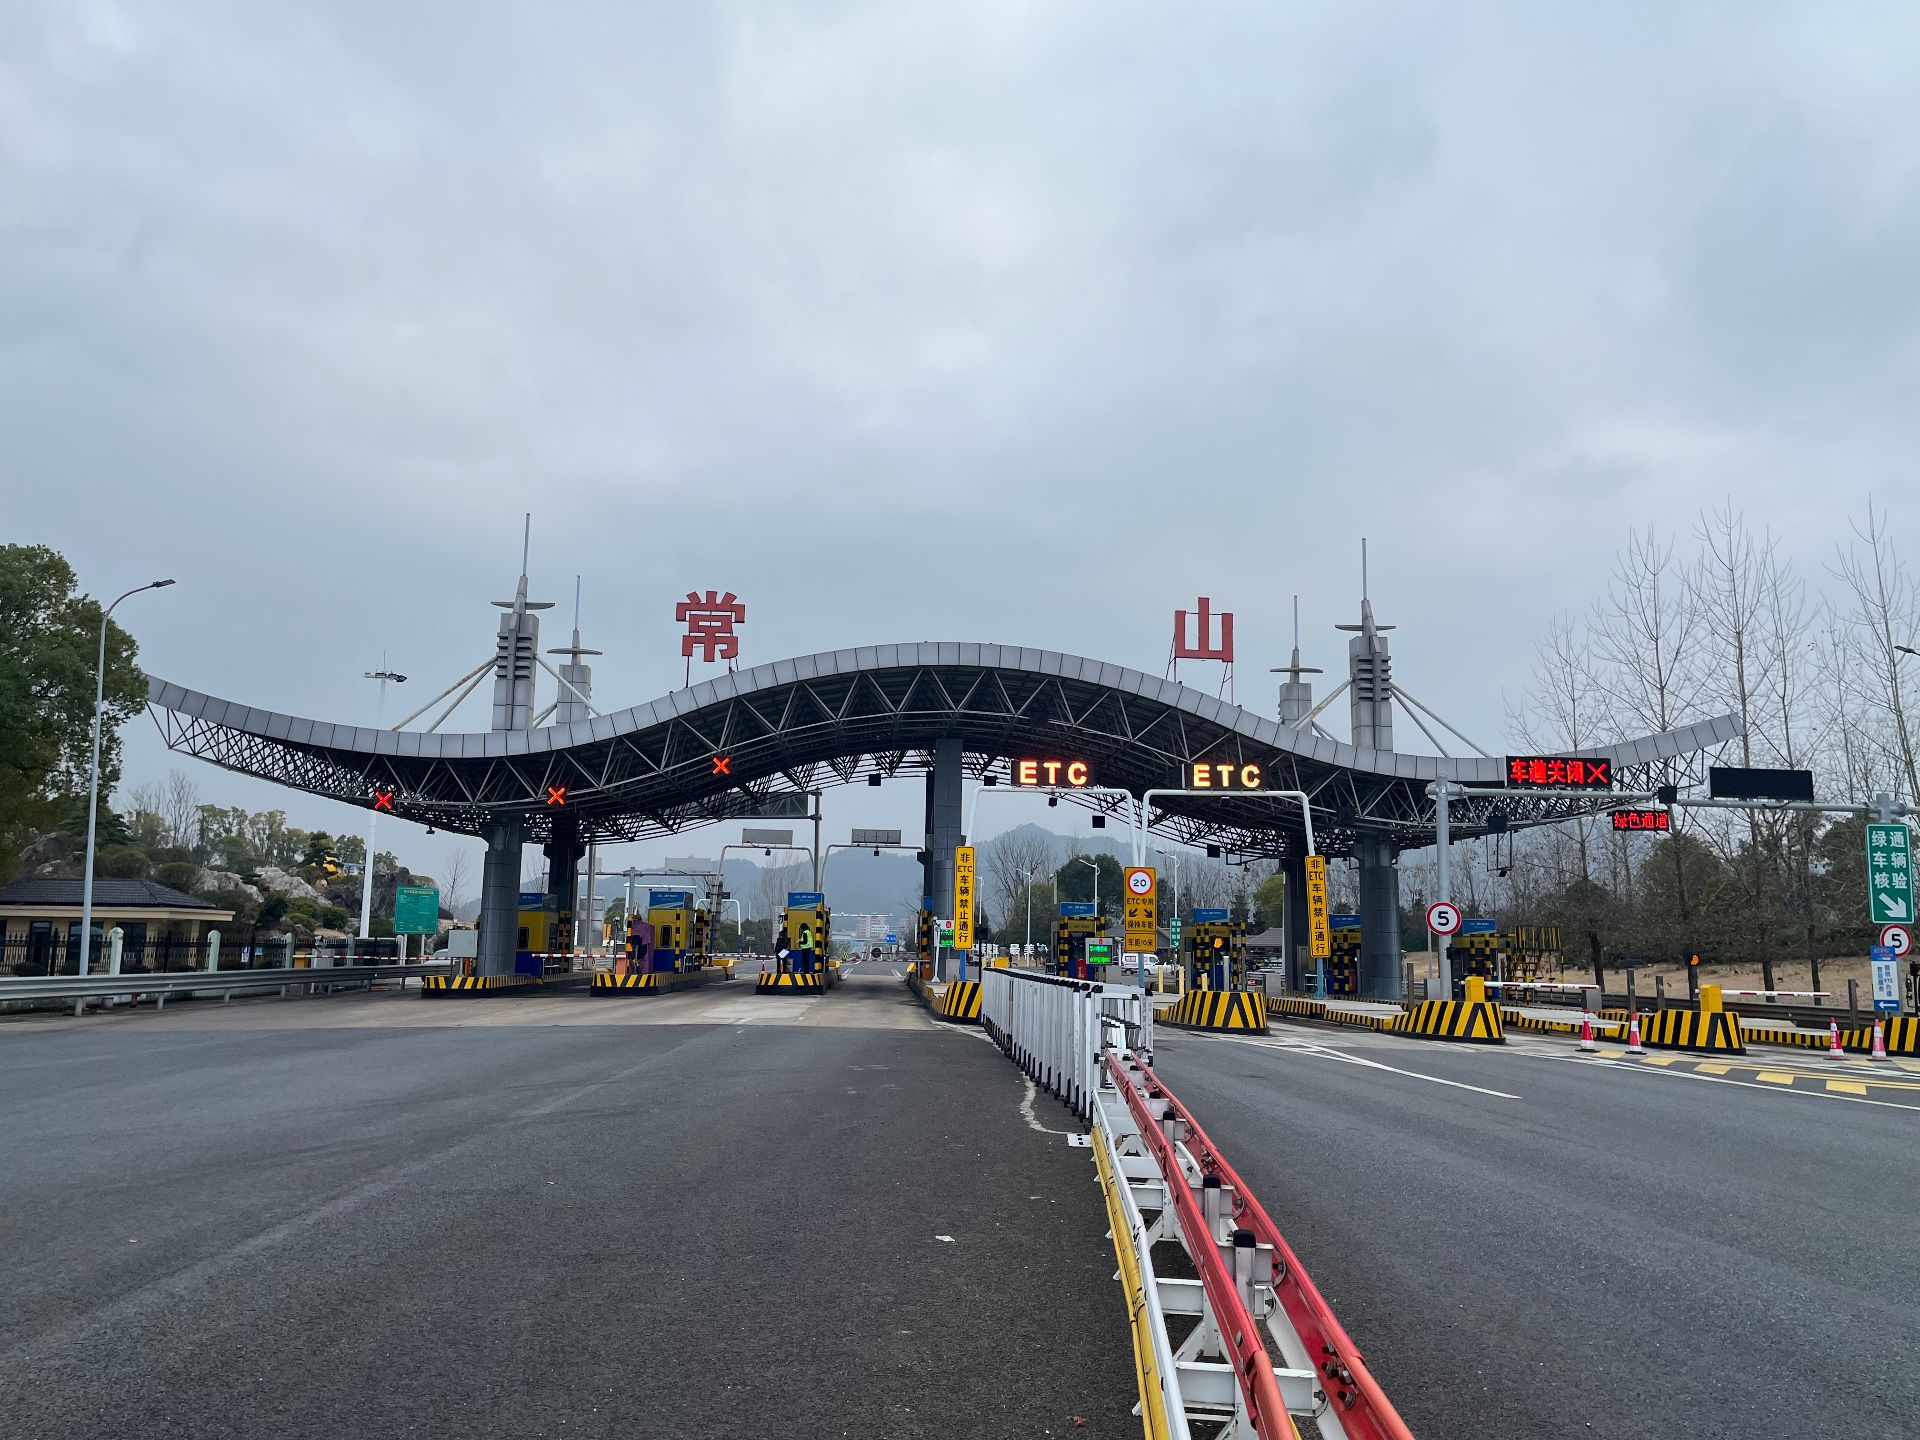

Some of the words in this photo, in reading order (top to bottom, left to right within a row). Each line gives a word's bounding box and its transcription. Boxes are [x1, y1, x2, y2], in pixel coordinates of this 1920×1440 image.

[676, 591, 745, 662] 常
[1175, 597, 1233, 662] 山
[1019, 760, 1087, 785] ETC
[1193, 763, 1261, 788] ETC
[1510, 759, 1585, 784] 车道关闭
[1614, 811, 1669, 830] 绿色通道
[1871, 830, 1905, 848] 绿通
[1873, 851, 1907, 869] 车辆
[1133, 879, 1147, 887] 20
[1874, 871, 1908, 889] 核验
[1127, 920, 1154, 929] 保持车距
[1437, 911, 1449, 926] 5
[1127, 938, 1154, 947] 车距10米
[1891, 933, 1902, 949] 5
